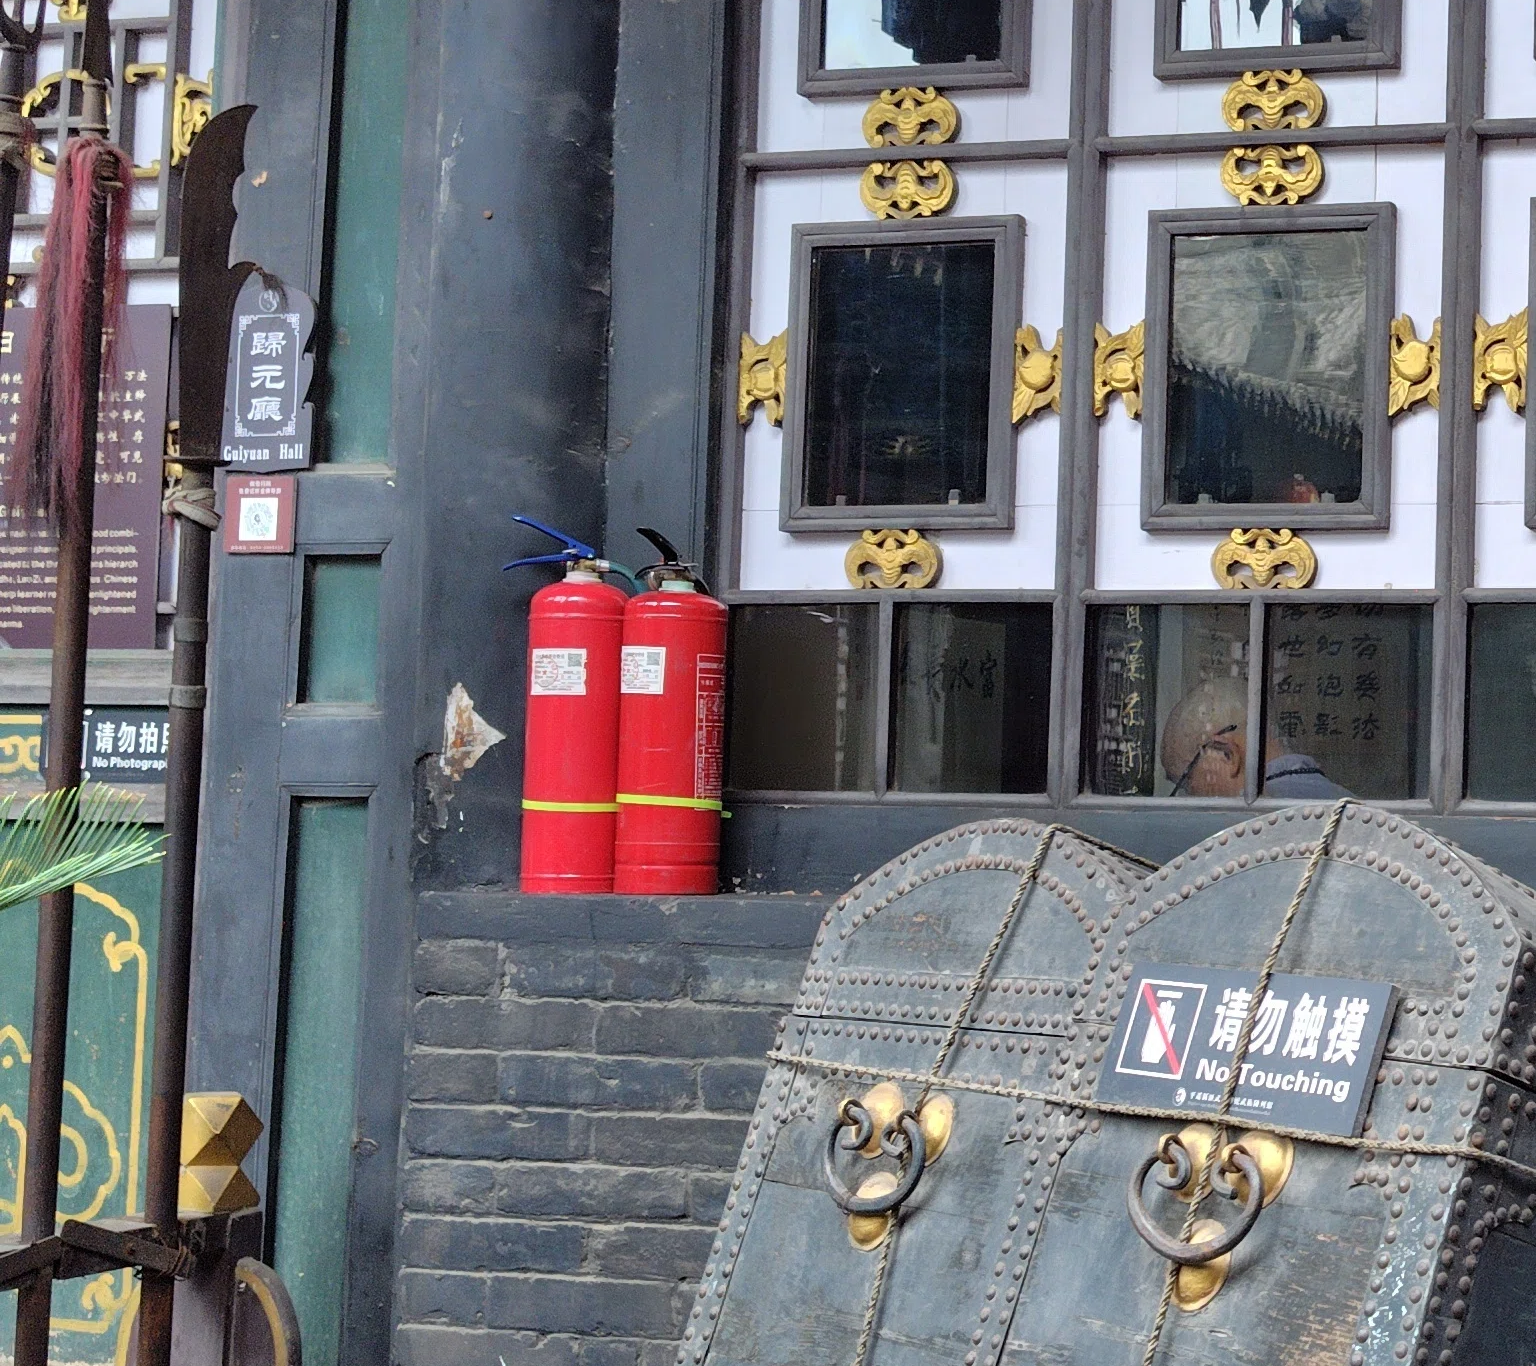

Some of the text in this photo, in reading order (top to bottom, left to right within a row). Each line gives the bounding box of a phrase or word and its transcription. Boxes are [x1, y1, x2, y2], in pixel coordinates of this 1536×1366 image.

[247, 330, 286, 422] 歸元廳
[223, 443, 304, 463] Guiyuan Hall
[92, 756, 109, 768] No
[1208, 987, 1370, 1067] 请勿触摸
[1195, 1058, 1351, 1102] No Touching
